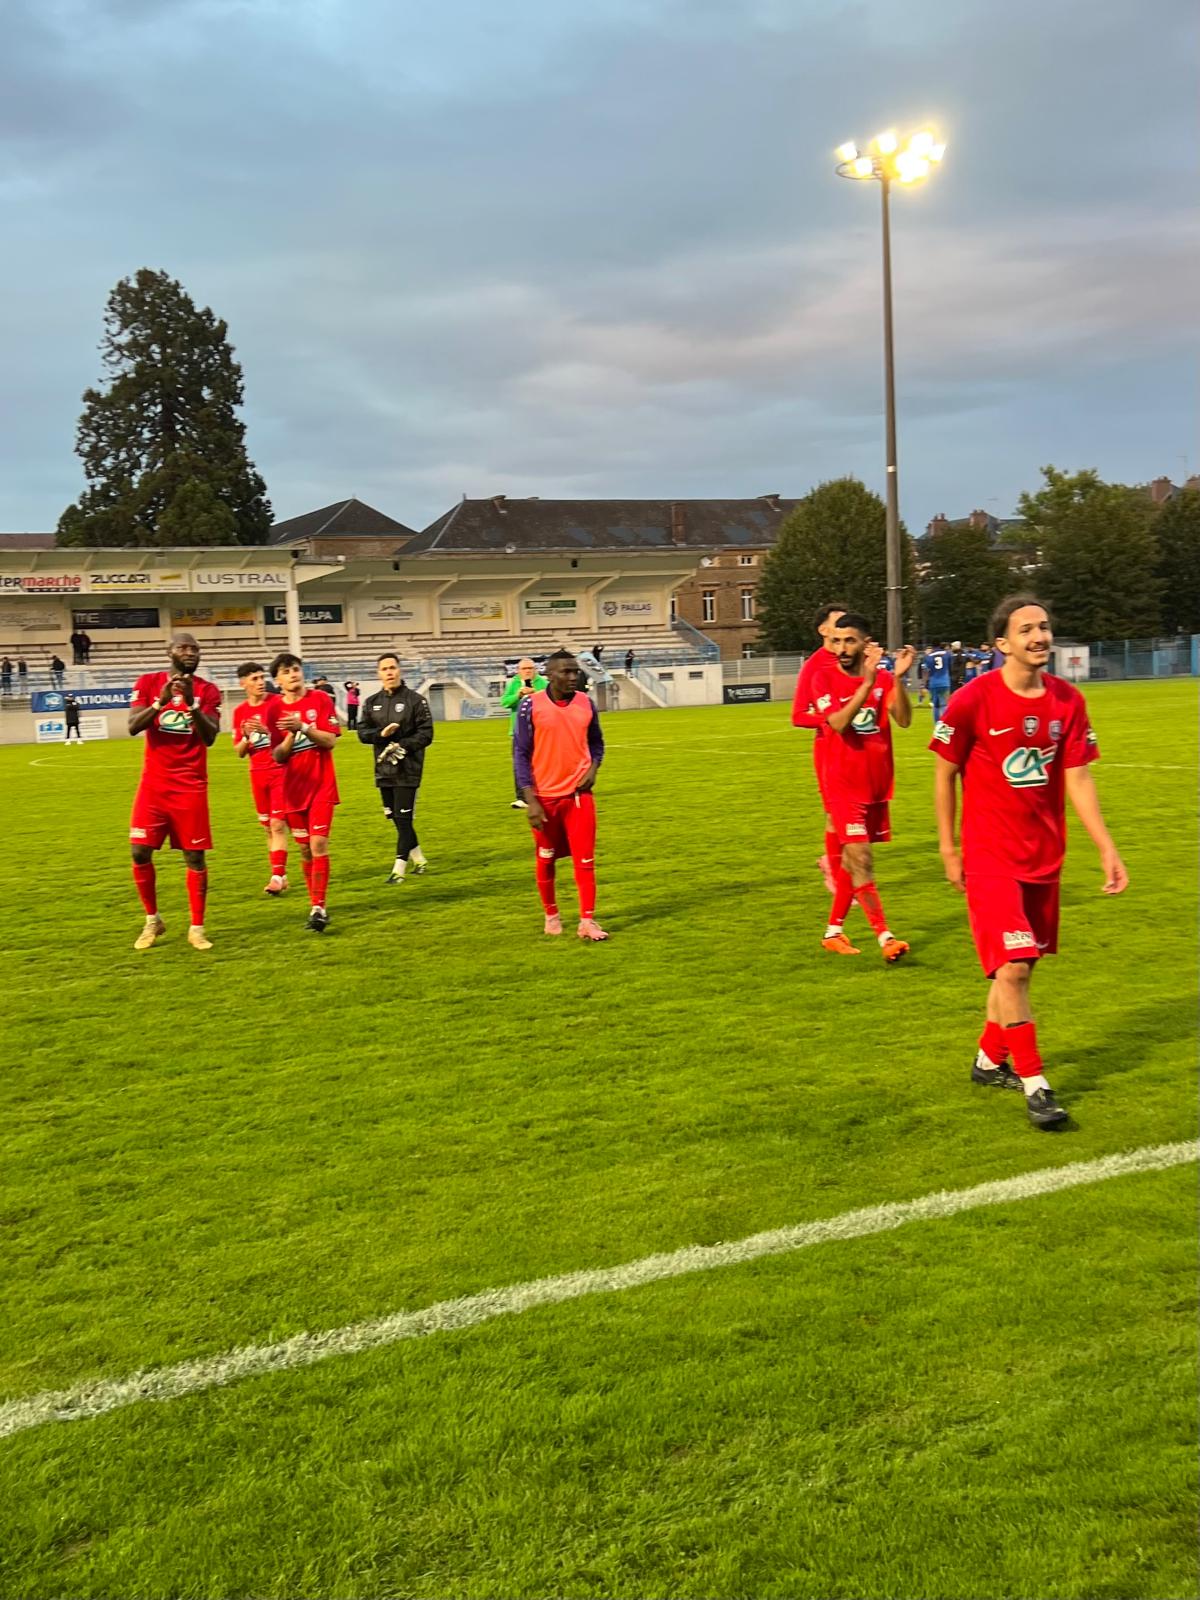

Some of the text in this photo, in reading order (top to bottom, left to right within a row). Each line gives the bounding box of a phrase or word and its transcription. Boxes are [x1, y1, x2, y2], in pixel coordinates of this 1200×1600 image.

[90, 574, 151, 584] ZUCCARI
[197, 573, 287, 584] LUSTRAL
[620, 603, 652, 611] PAILLAS
[278, 610, 333, 621] MBALPA
[934, 656, 943, 670] 3
[75, 694, 126, 705] ATIONAL
